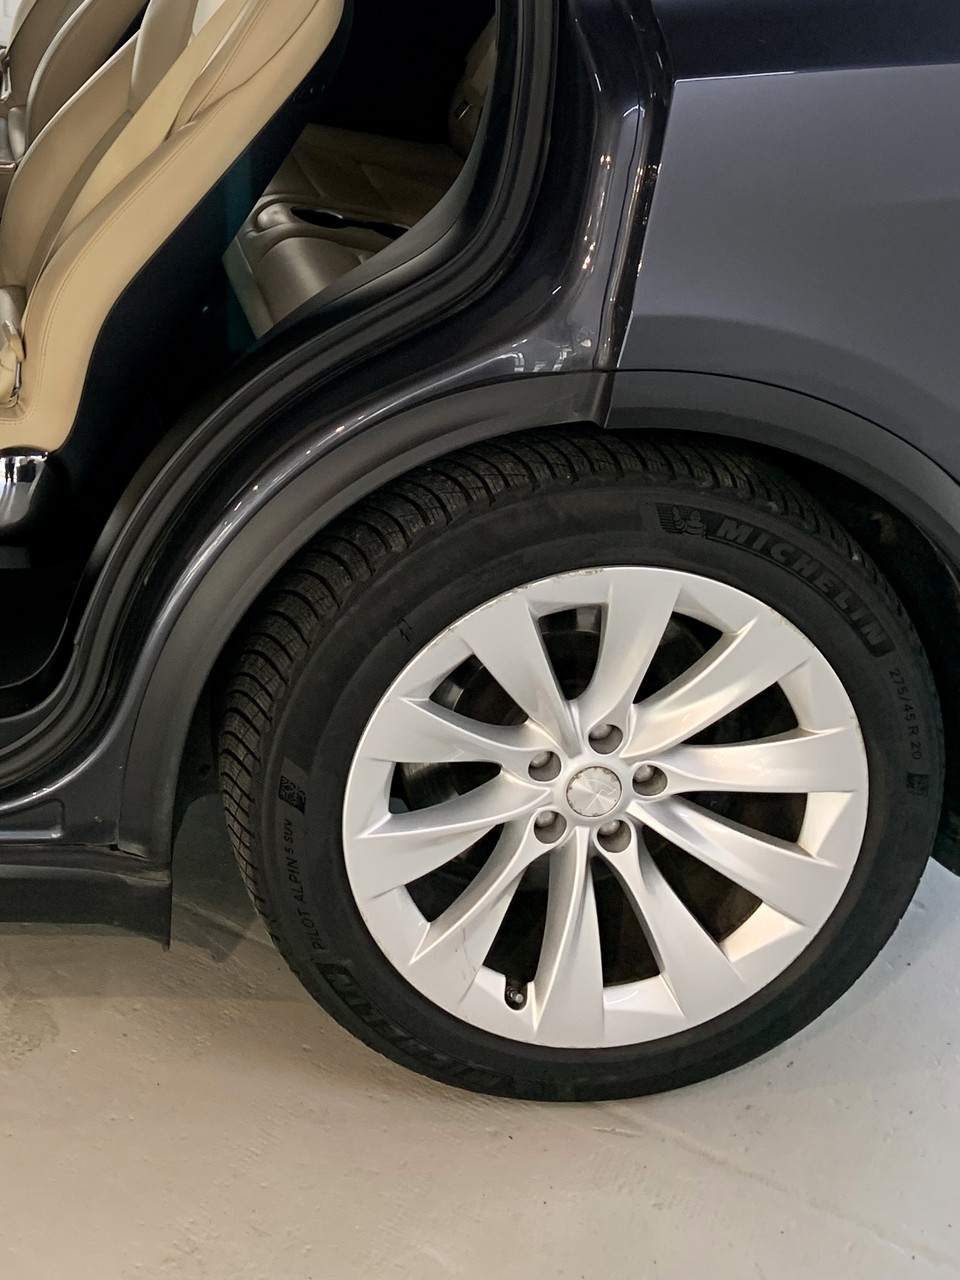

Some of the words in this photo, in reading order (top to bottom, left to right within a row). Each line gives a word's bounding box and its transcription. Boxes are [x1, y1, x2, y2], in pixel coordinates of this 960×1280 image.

[717, 519, 887, 647] MICHELIN
[889, 668, 917, 721] 275/45
[908, 726, 919, 736] R
[910, 744, 922, 761] 20
[283, 818, 293, 843] SUV
[284, 846, 294, 854] 5
[286, 857, 305, 903] ALPIN
[297, 907, 326, 950] PILOT
